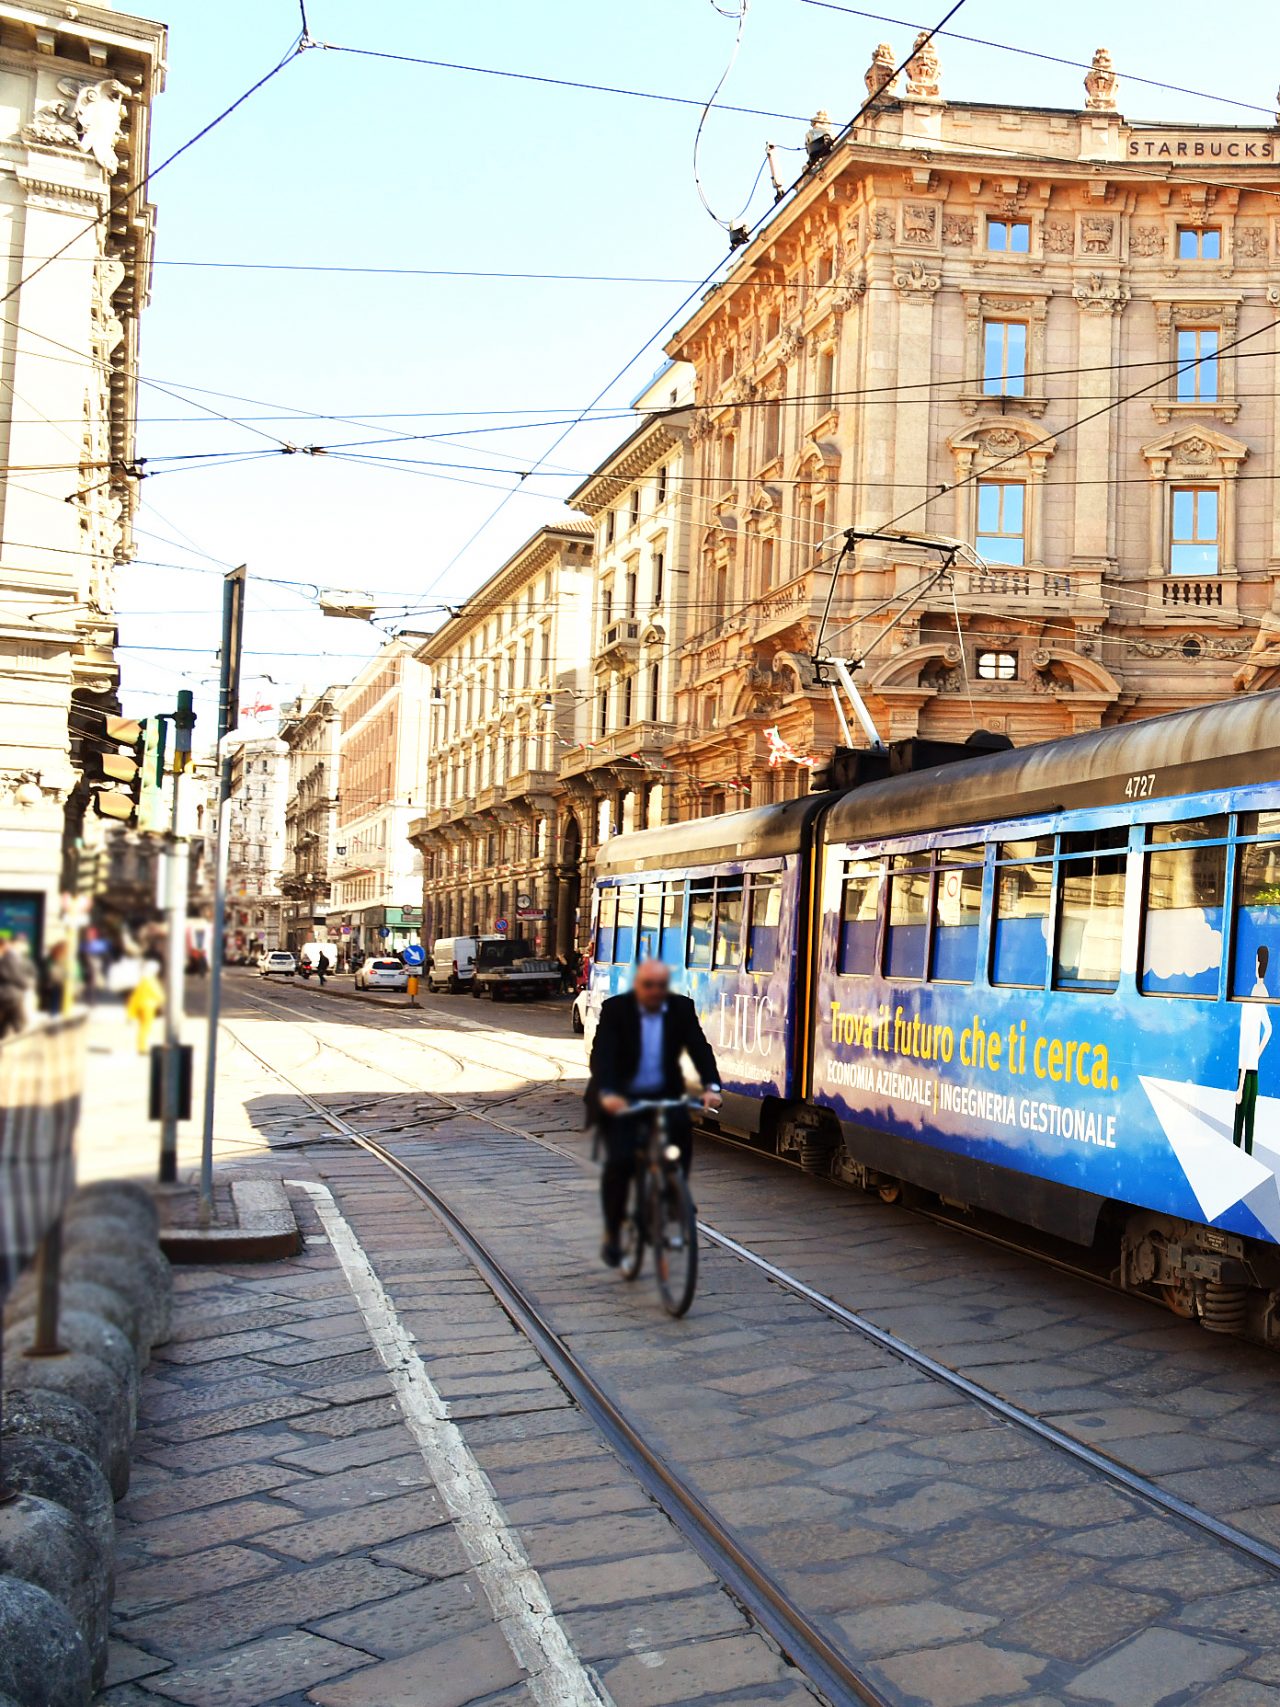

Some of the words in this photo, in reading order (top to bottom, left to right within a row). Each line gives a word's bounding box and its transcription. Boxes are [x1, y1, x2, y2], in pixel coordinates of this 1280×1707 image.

[1129, 141, 1272, 157] STARBUCKS
[1125, 774, 1156, 798] 4727
[718, 992, 773, 1057] LIUC
[830, 1001, 873, 1050] Trova
[877, 1004, 889, 1052] il
[894, 1005, 954, 1064] futuro
[960, 1015, 1002, 1072] che
[1008, 1019, 1027, 1075] ti
[1033, 1037, 1119, 1091] cerca.
[826, 1059, 875, 1093] ECONOMIA
[875, 1071, 932, 1107] AZIENDALE
[940, 1082, 1017, 1127] INGEGNERIA
[1019, 1099, 1117, 1149] GESTIONALE
